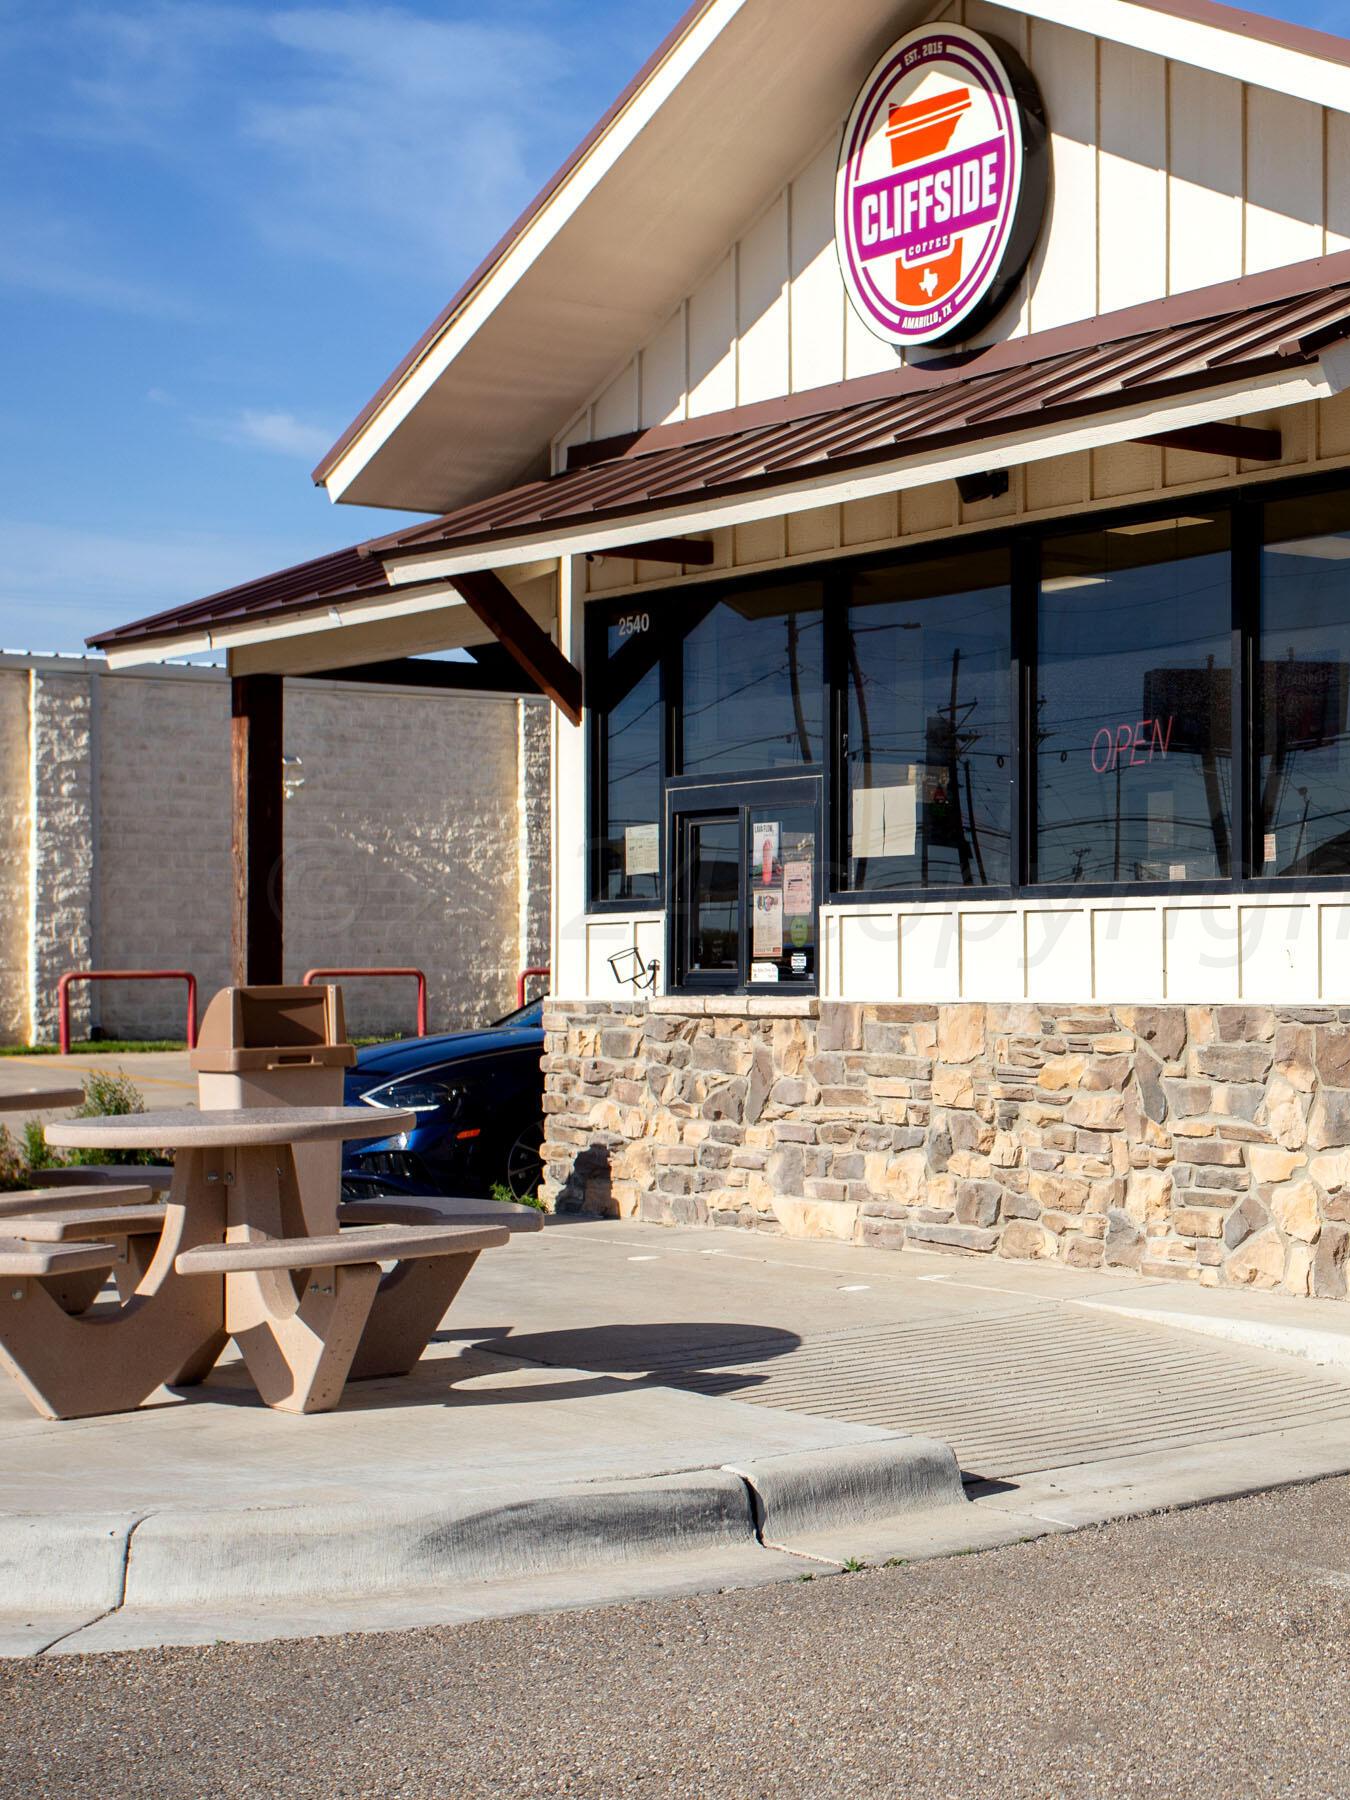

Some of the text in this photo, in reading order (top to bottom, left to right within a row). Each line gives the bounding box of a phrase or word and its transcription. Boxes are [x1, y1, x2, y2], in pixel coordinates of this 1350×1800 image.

[904, 41, 944, 66] EST. 2015
[861, 151, 998, 247] CLIFFSIDE
[908, 236, 950, 256] COFFEE
[901, 304, 953, 329] AMARILLO, TX
[618, 613, 650, 636] 2540
[1091, 714, 1175, 774] OPEN
